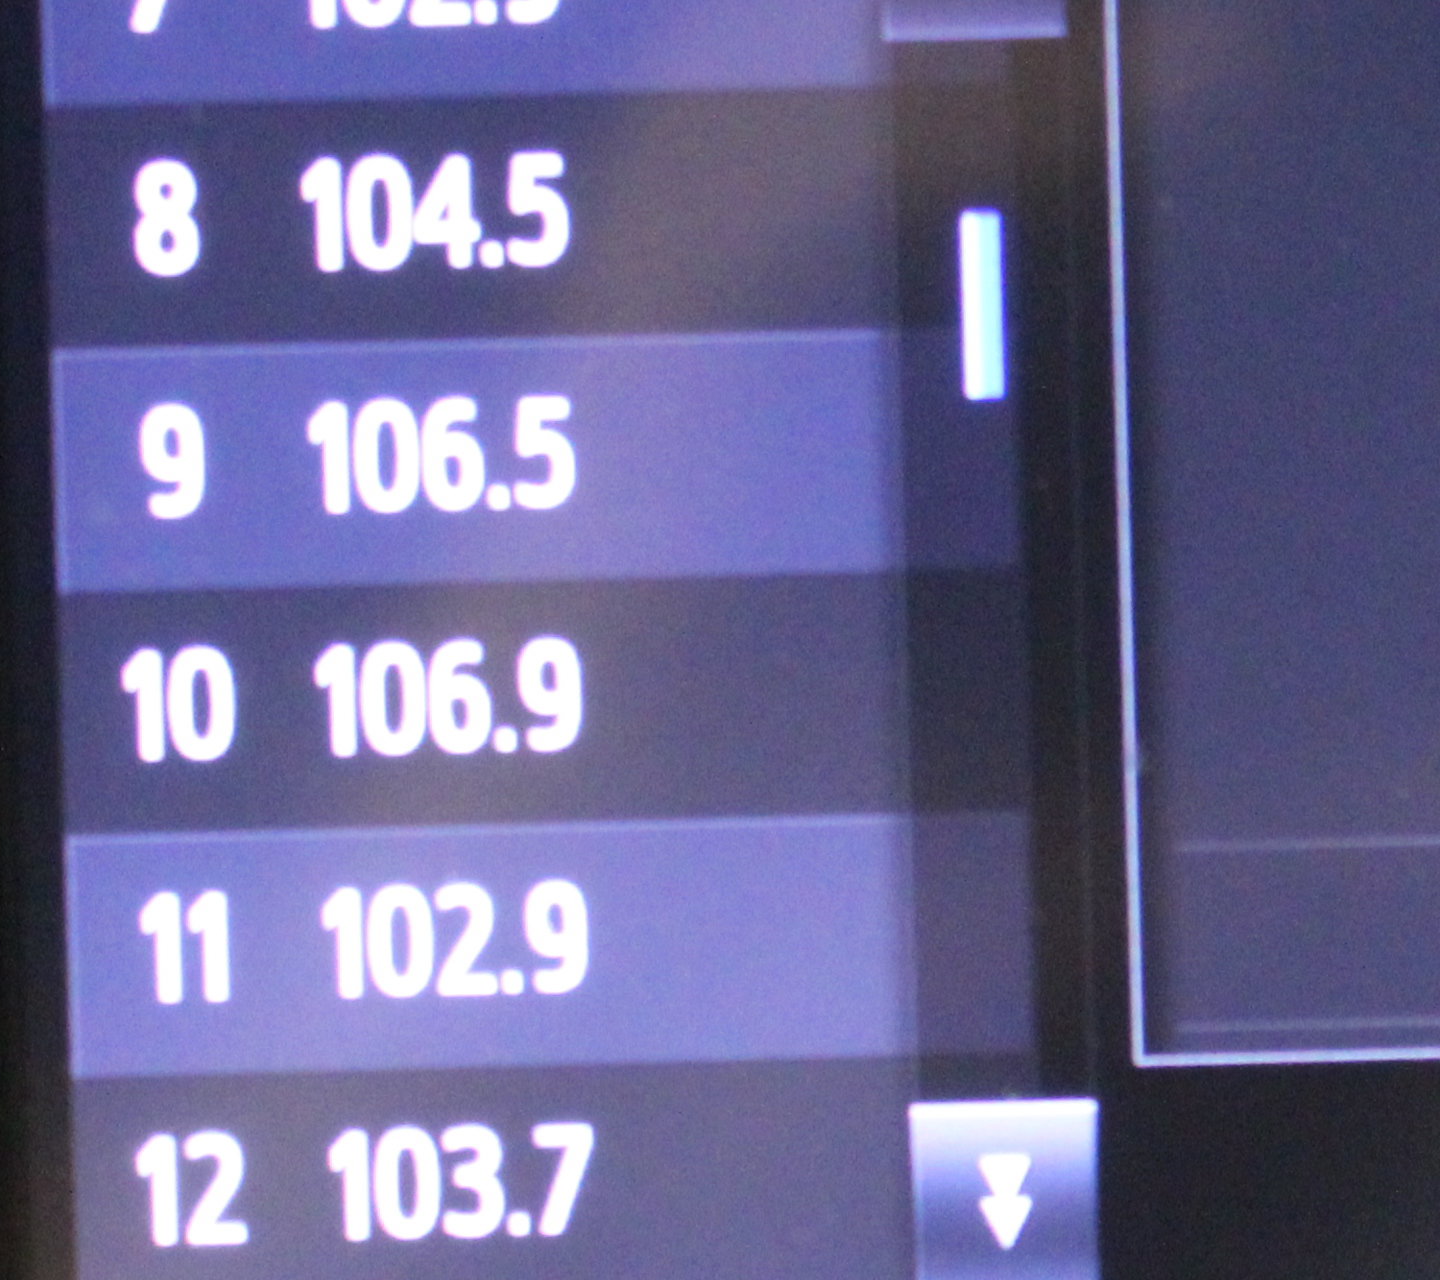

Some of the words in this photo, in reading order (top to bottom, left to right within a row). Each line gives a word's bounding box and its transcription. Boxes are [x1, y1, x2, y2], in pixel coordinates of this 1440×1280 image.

[134, 159, 200, 277] 8
[300, 151, 570, 272] 104.5
[140, 403, 205, 519] 9
[307, 395, 576, 514] 106.5
[122, 645, 236, 762] 10
[314, 636, 583, 758] 106.9
[139, 890, 230, 1004] 11
[321, 879, 589, 1000] 102.9
[135, 1130, 248, 1247] 12
[328, 1122, 594, 1242] 103.7
